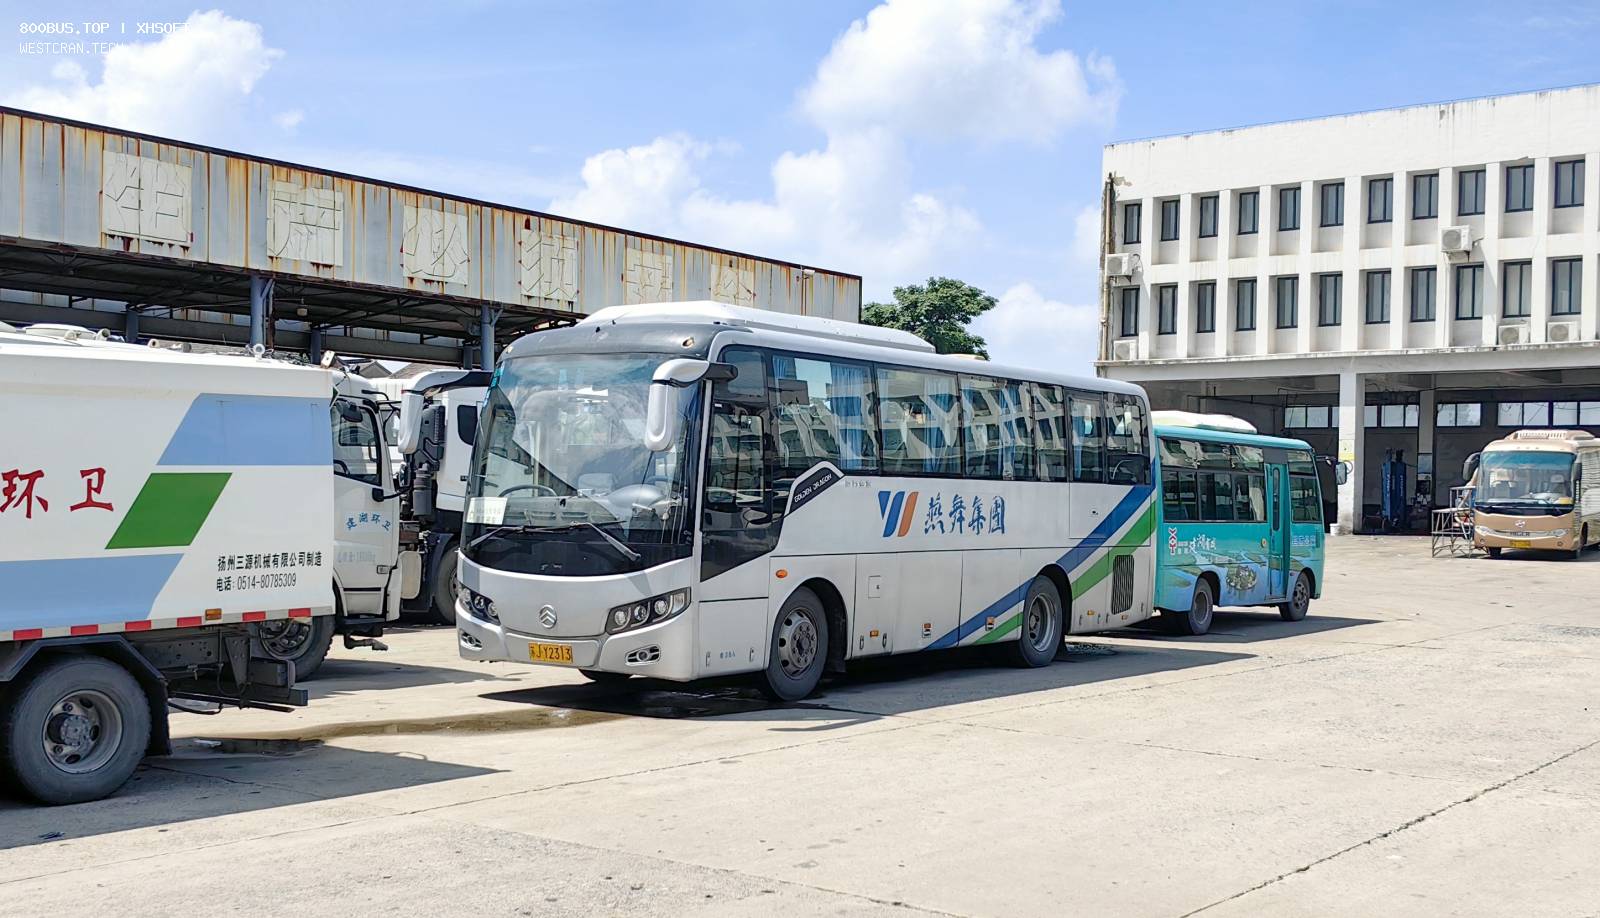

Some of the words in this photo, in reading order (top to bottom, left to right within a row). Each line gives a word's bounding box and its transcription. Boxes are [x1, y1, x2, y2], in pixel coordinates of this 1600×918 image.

[0, 467, 114, 519] 环卫
[794, 486, 812, 503] GOLDEN
[217, 551, 323, 572] 扬州三源机械有限公司制造
